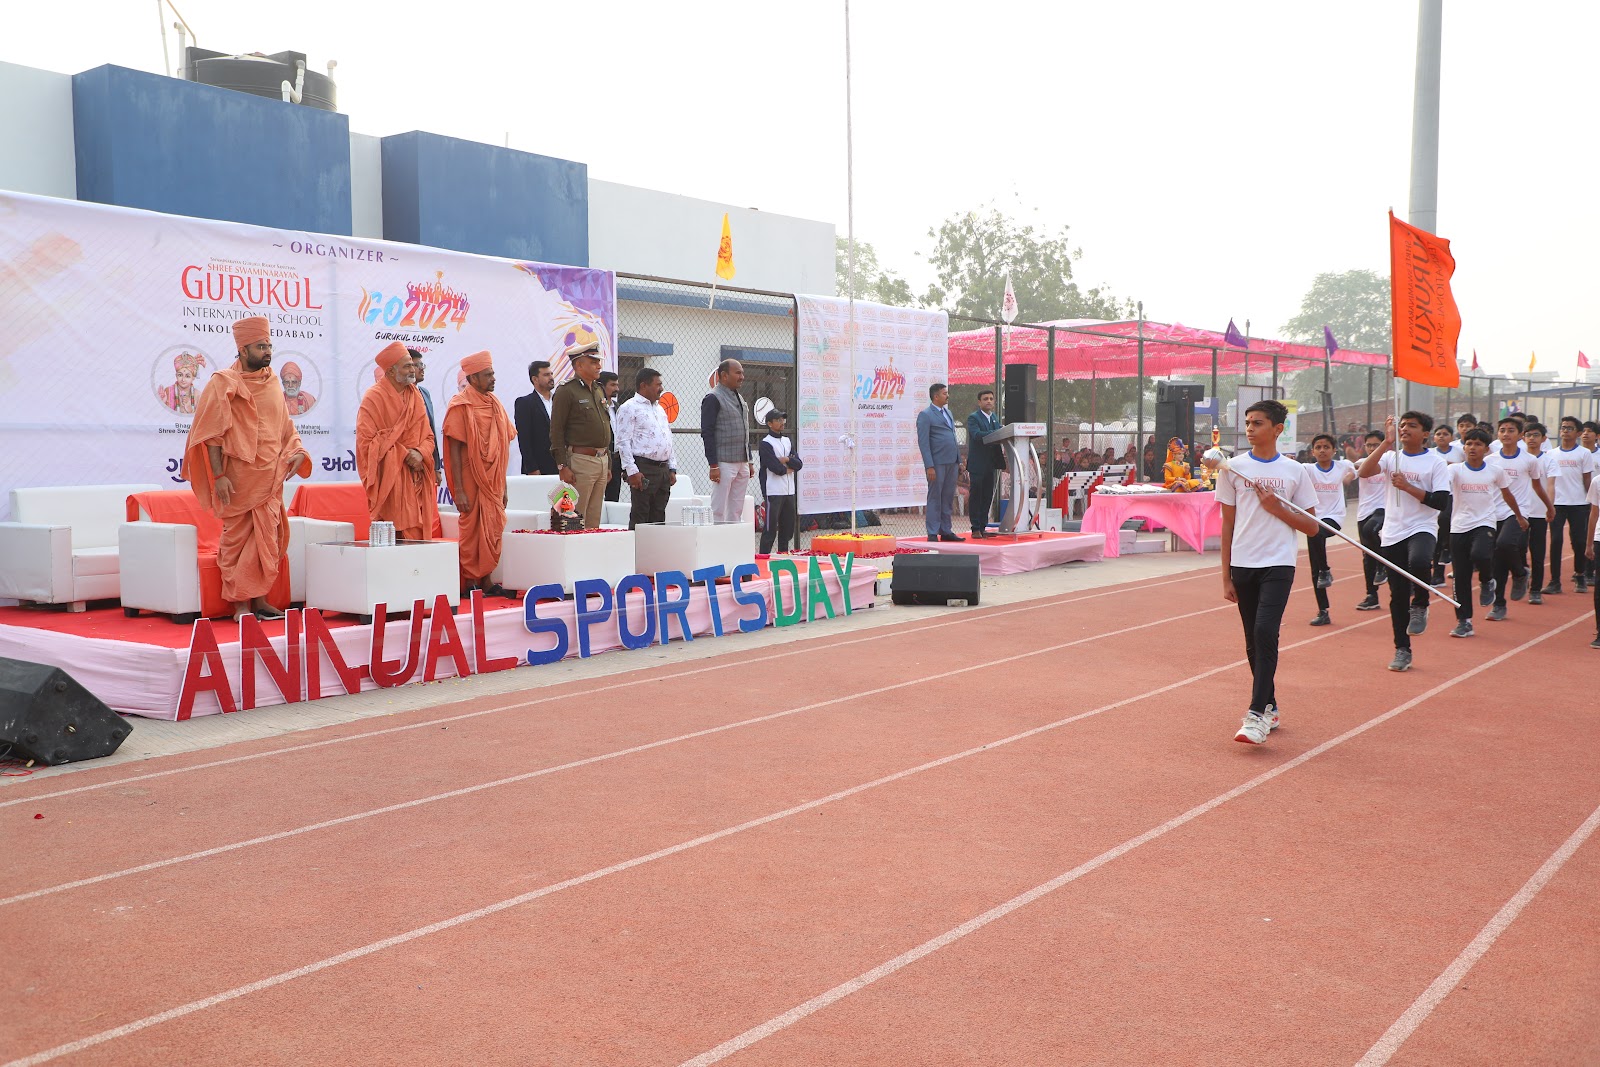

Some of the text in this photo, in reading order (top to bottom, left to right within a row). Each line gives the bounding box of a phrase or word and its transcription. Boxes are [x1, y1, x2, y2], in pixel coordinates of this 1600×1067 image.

[290, 240, 384, 262] ORGANIZER
[207, 263, 299, 280] SHREE SWAMINARAYAN
[181, 265, 323, 313] GURUKUL
[362, 288, 470, 332] GO2024
[277, 313, 324, 327] SCHOOL
[270, 328, 315, 339] EDABAD
[375, 331, 445, 344] GURUKUL OLYMPICS
[175, 422, 191, 430] Bhag
[175, 552, 855, 721] ANNUAL SPORTS DAY
